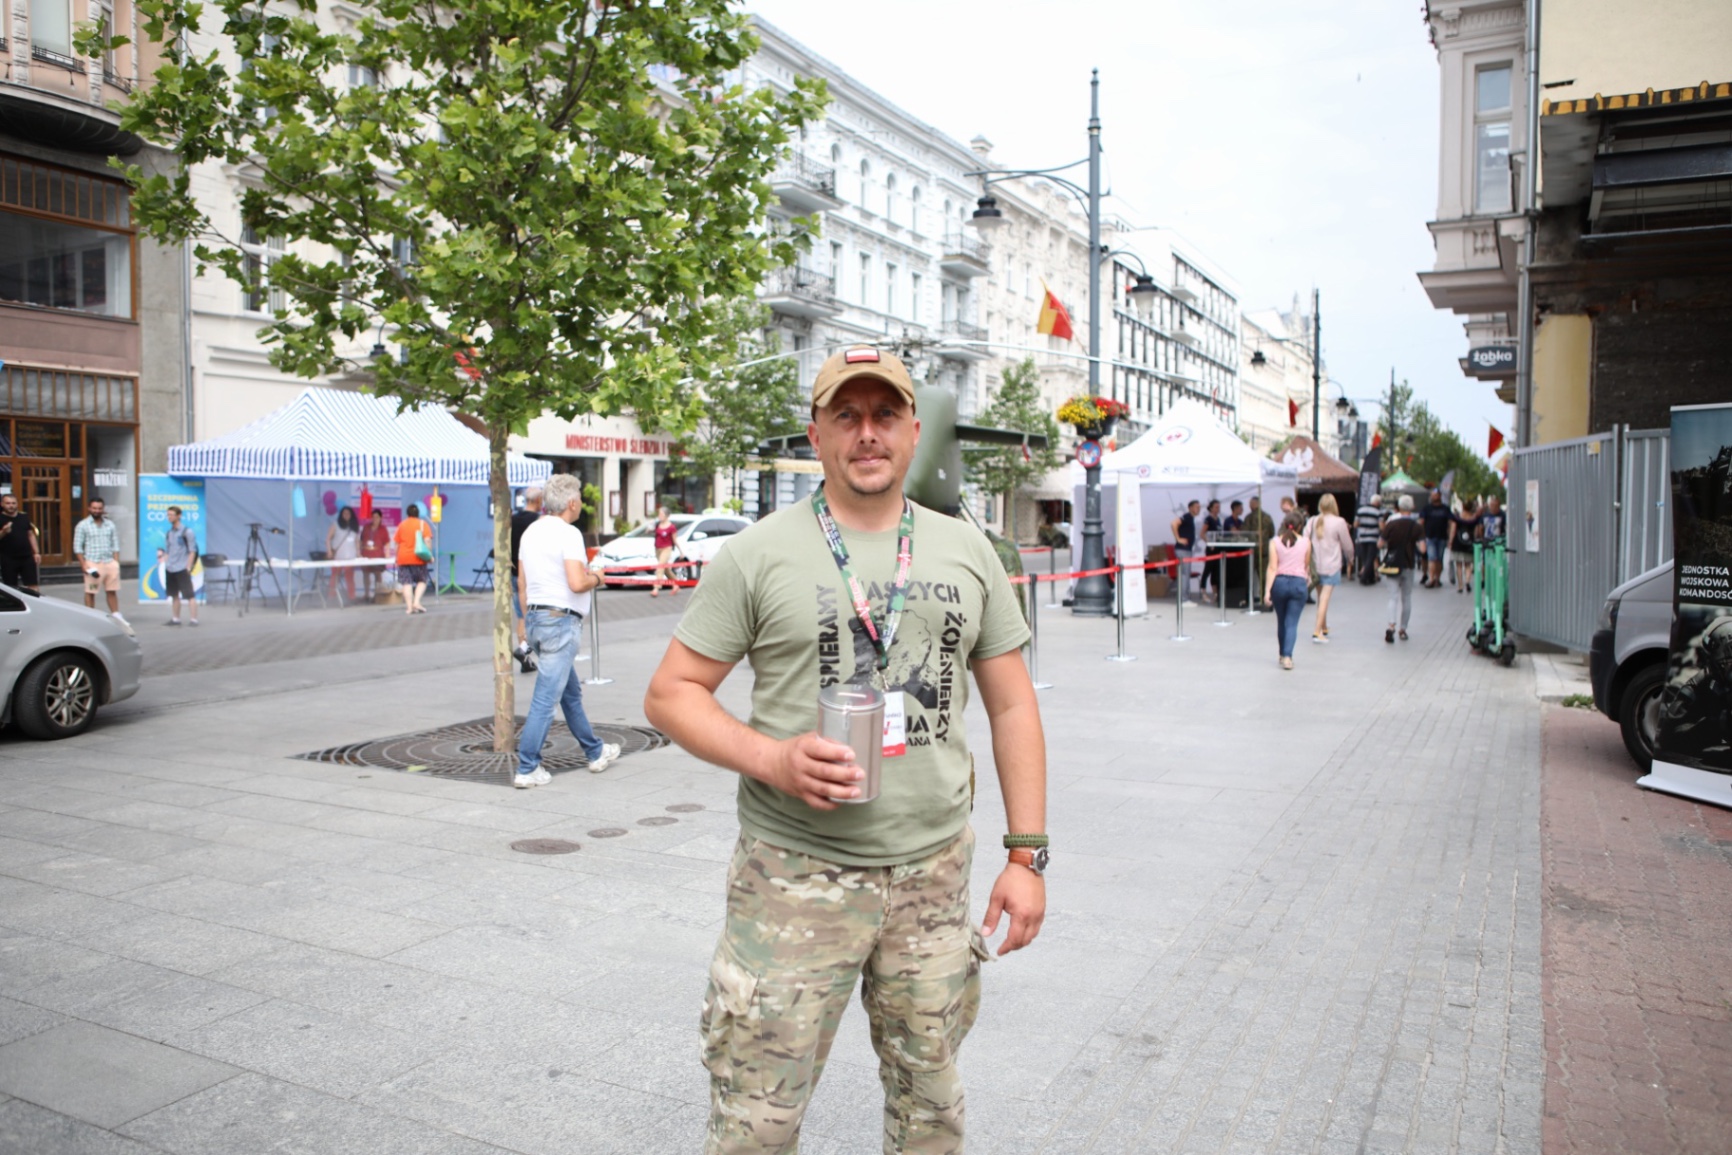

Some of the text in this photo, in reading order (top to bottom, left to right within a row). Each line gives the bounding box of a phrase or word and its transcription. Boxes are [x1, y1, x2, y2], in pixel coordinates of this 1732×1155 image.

[1473, 350, 1512, 362] żabka
[566, 434, 627, 453] MINISTERSTWO
[147, 503, 199, 511] PRZEWKO
[147, 511, 199, 521] CO-19
[1681, 565, 1730, 576] JEDNOSTKA
[1680, 576, 1730, 588] WOJSKOWA
[861, 580, 961, 604] ASZYCH
[1679, 587, 1732, 600] KOMANDOSÓ
[816, 584, 840, 689] SPIERAMY
[935, 611, 967, 742] ŻOŁNIERZY
